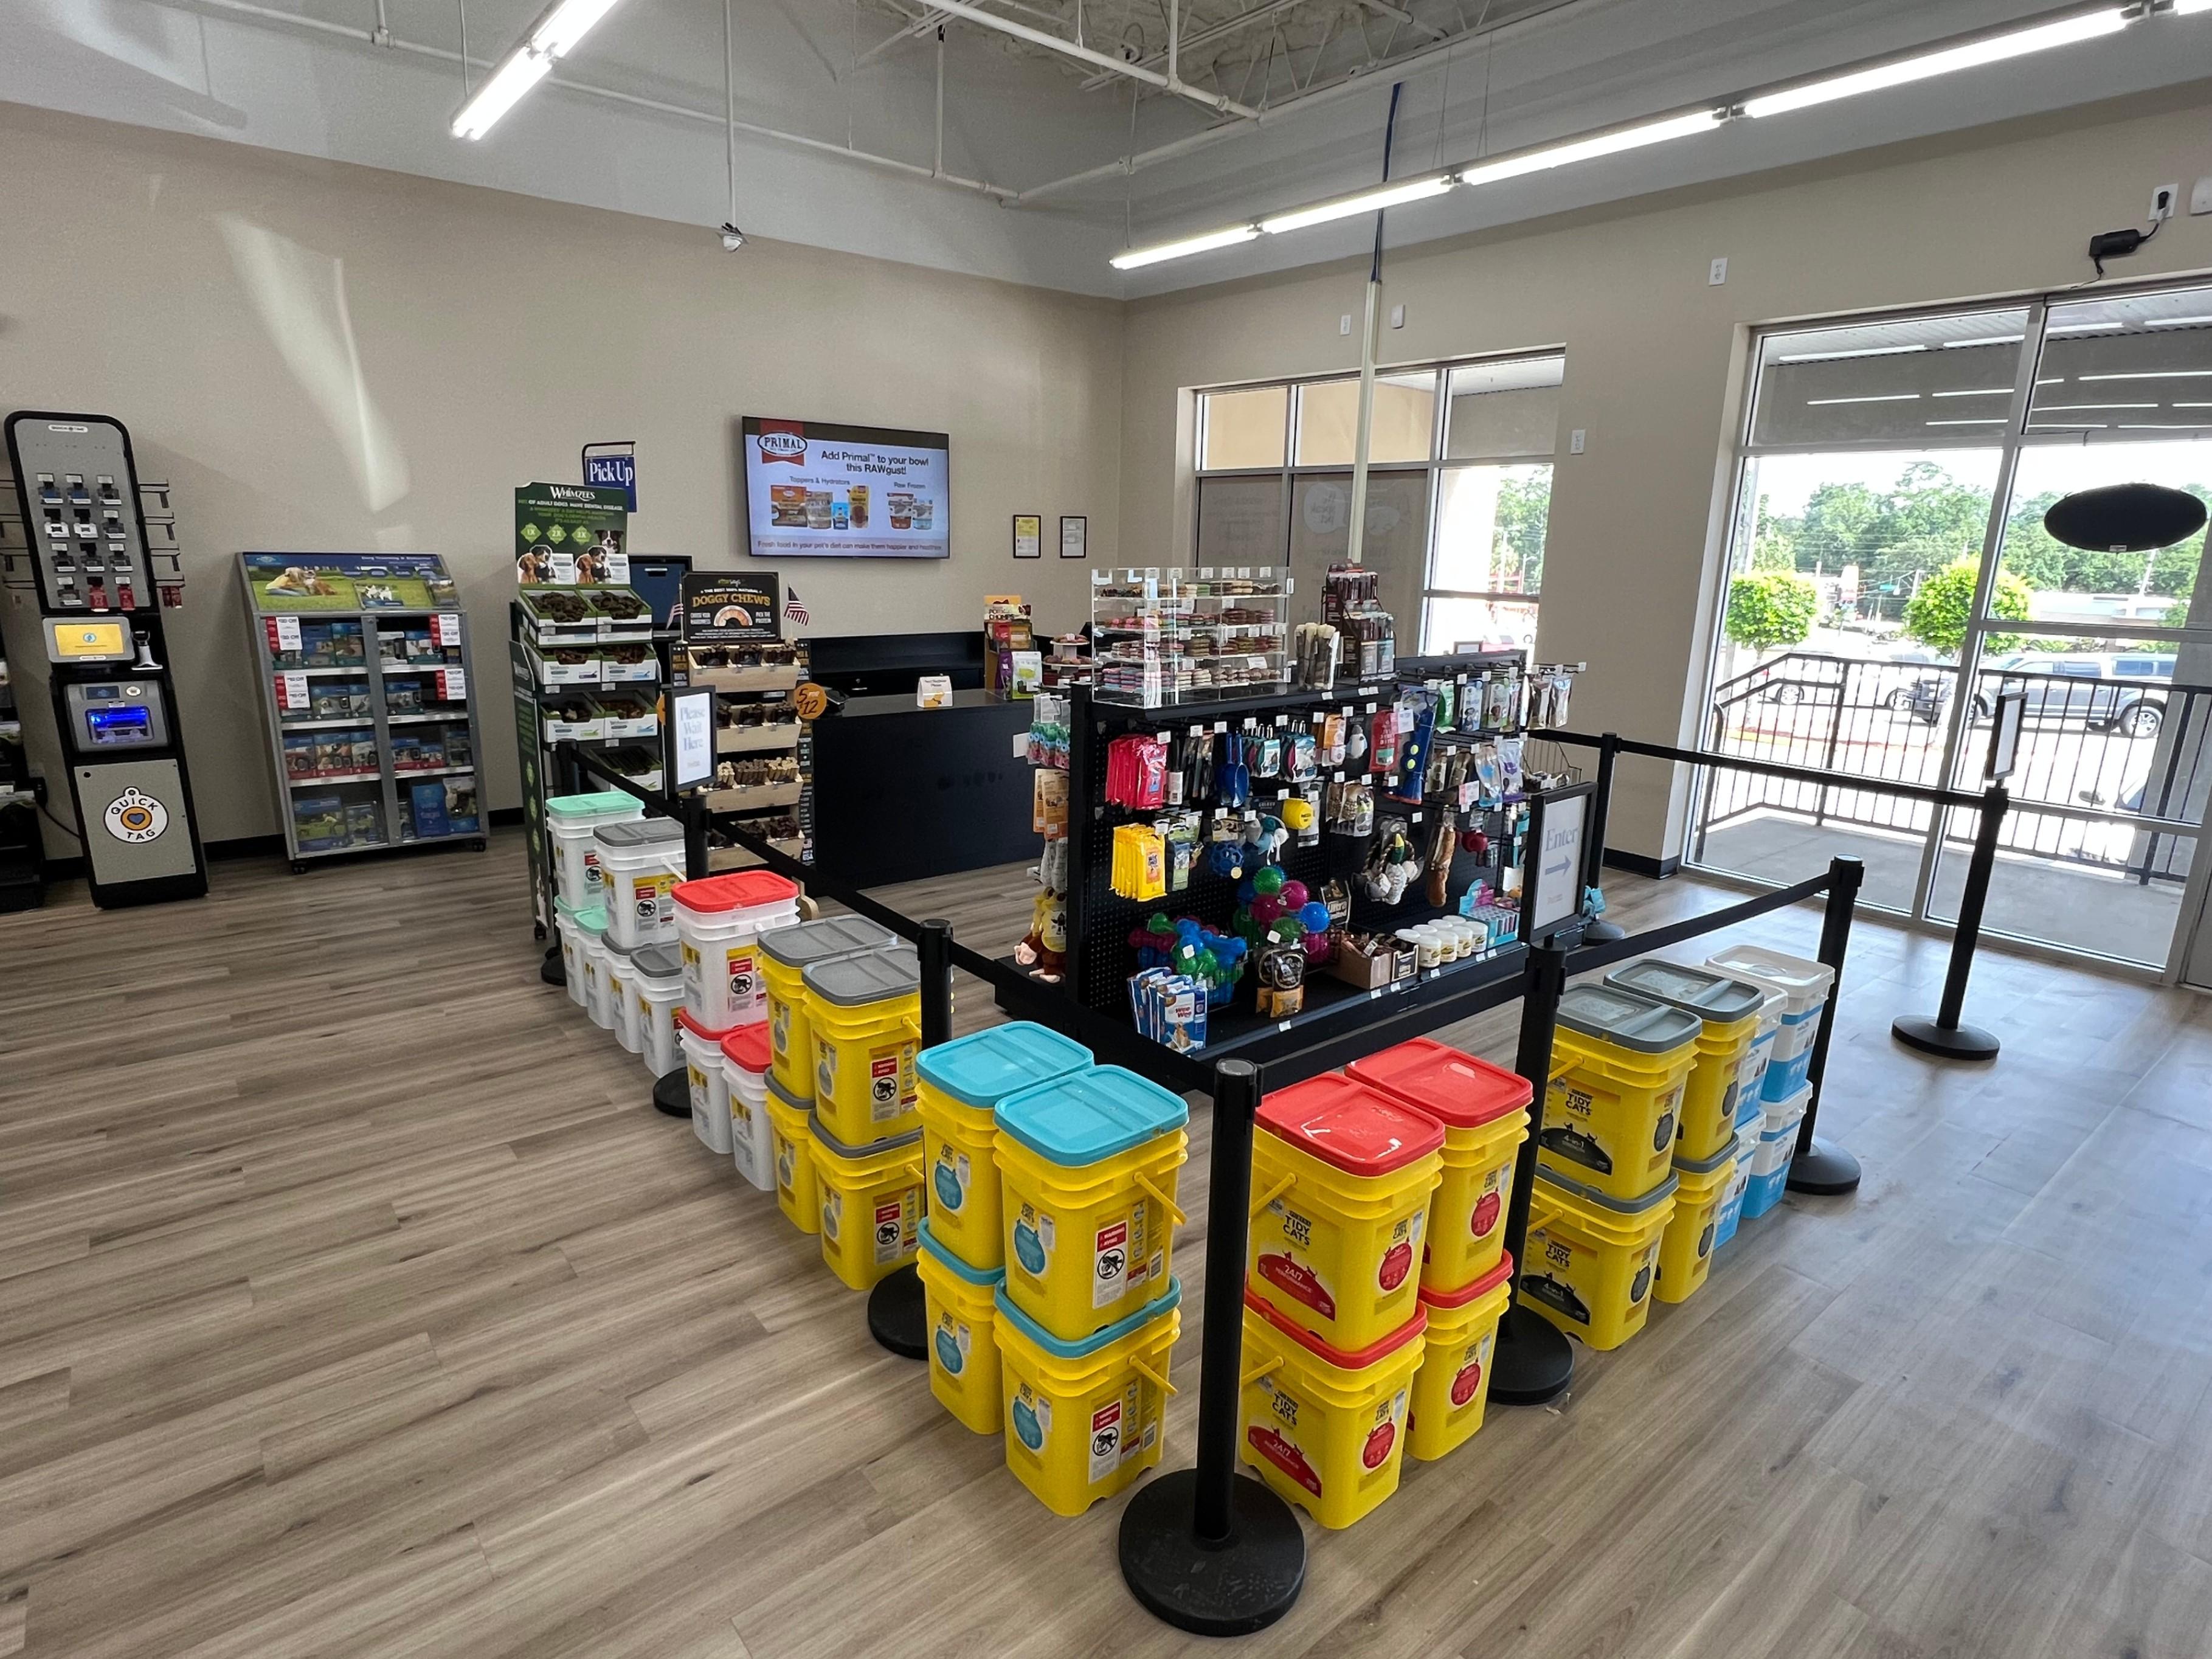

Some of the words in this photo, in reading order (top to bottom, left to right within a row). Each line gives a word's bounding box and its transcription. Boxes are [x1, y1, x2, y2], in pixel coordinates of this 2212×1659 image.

[764, 437, 802, 449] PRIMAL
[821, 451, 840, 460] Add
[909, 457, 928, 466] bowl
[589, 462, 615, 482] Pick
[616, 462, 633, 486] Up
[846, 463, 862, 472] this
[865, 464, 907, 476] RAWgust!
[693, 594, 729, 608] DOGGY
[730, 594, 770, 606] CHEWS
[797, 688, 809, 704] 5
[680, 707, 705, 721] Please
[683, 721, 702, 735] Wait
[683, 738, 703, 751] Here
[111, 797, 158, 814] QUICK
[127, 830, 156, 840] TAG
[1545, 827, 1578, 851] Enter
[1567, 1093, 1591, 1107] TIDY
[1566, 1101, 1592, 1116] CATS
[1285, 1214, 1310, 1235] TIDY
[1283, 1224, 1310, 1245] CATS
[1546, 1250, 1571, 1267] CATS
[1547, 1243, 1569, 1259] TIDY
[1274, 1393, 1297, 1416] TIDY
[1273, 1402, 1297, 1426] CATS
